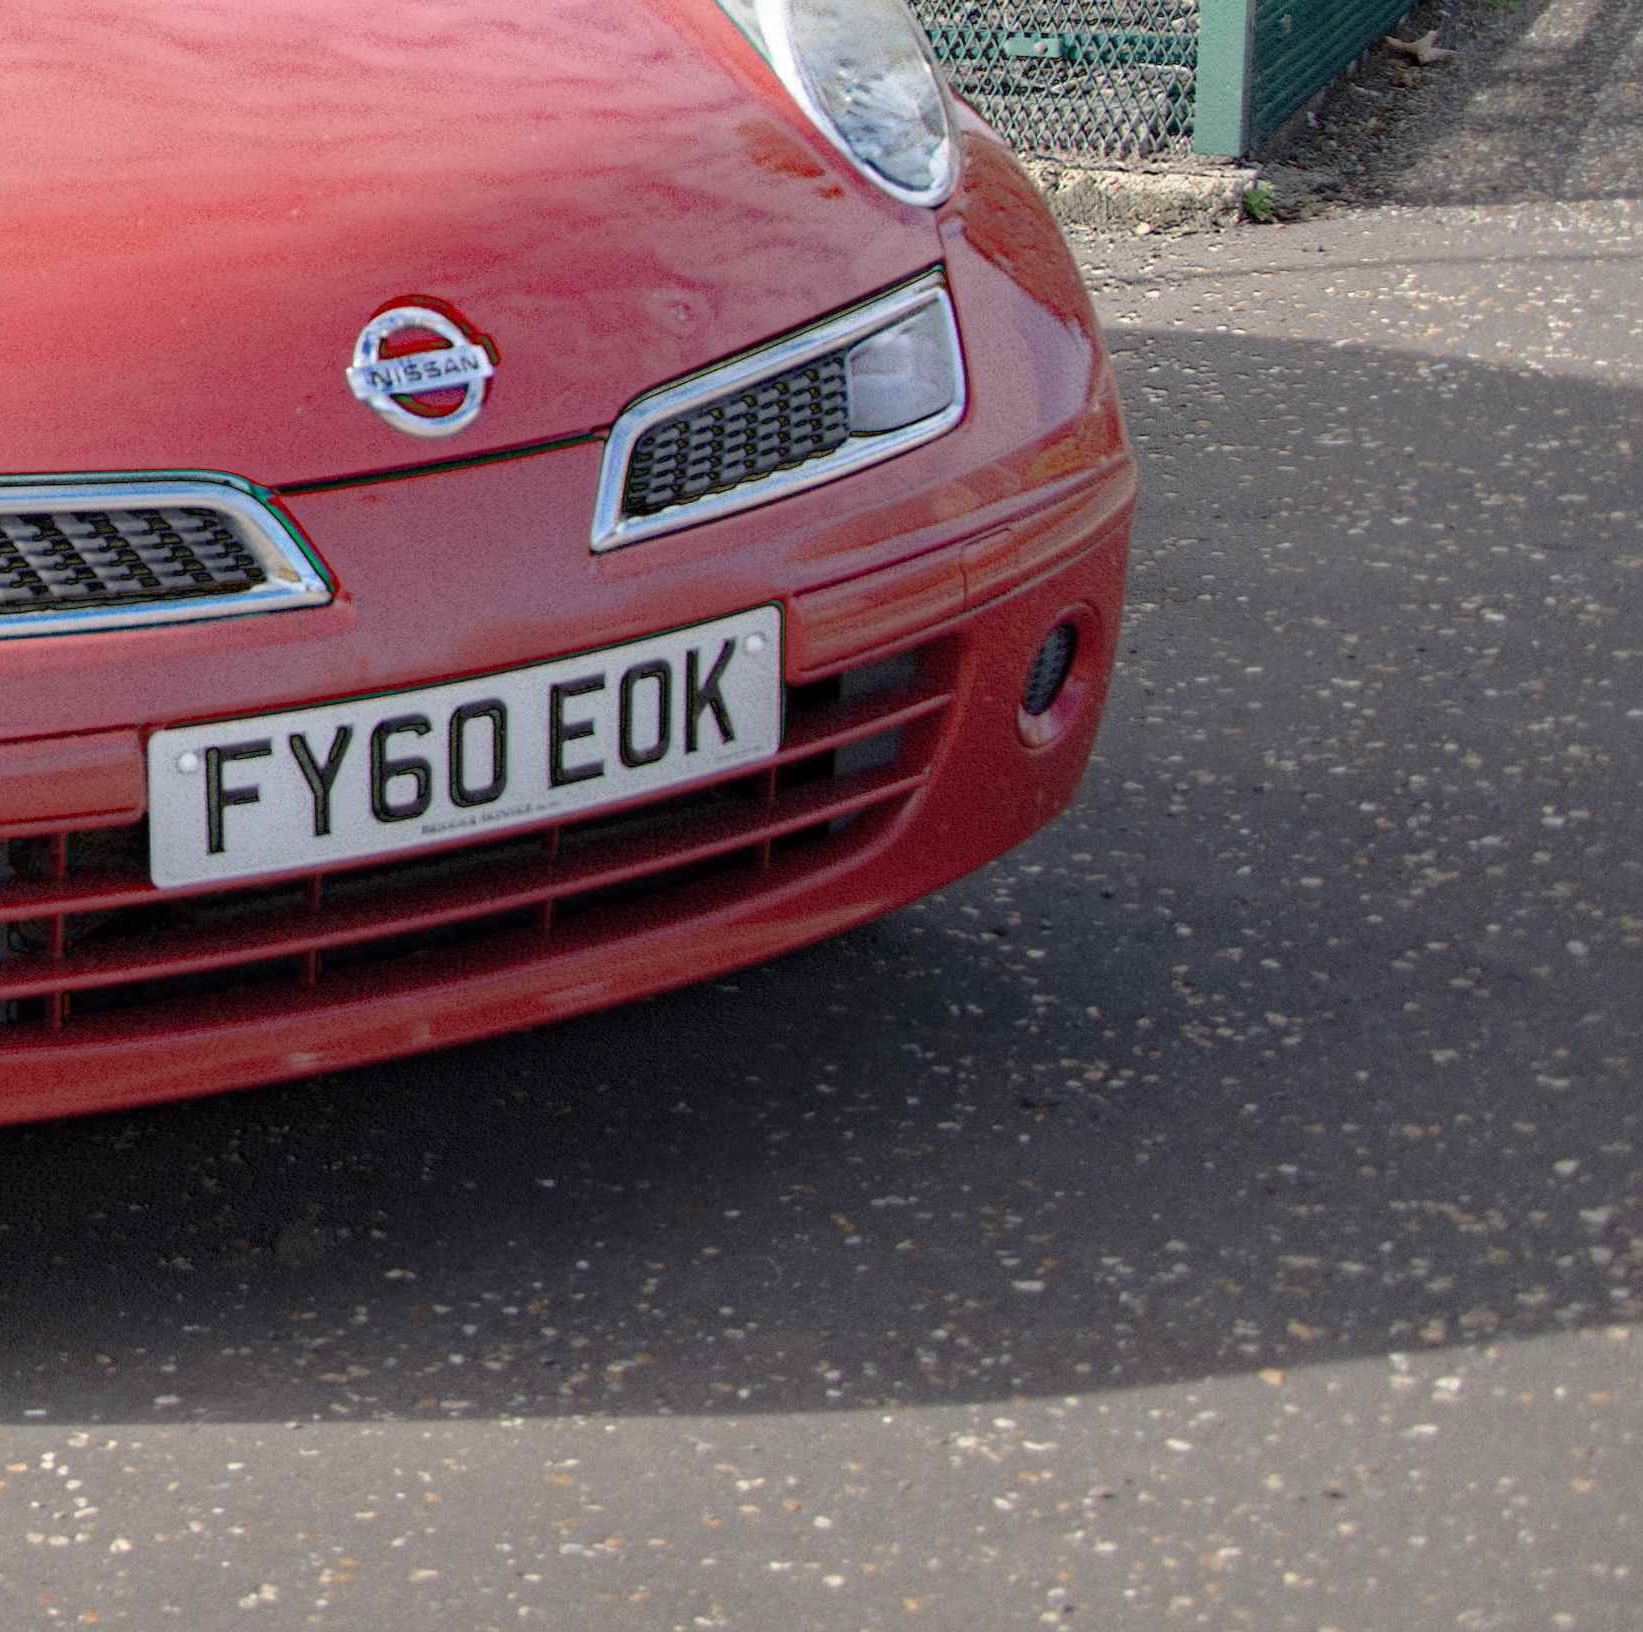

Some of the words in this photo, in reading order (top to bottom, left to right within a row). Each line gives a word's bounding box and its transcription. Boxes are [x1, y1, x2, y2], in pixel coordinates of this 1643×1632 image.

[369, 353, 480, 389] NISSAN
[203, 696, 509, 856] FY60
[547, 636, 739, 790] EOK
